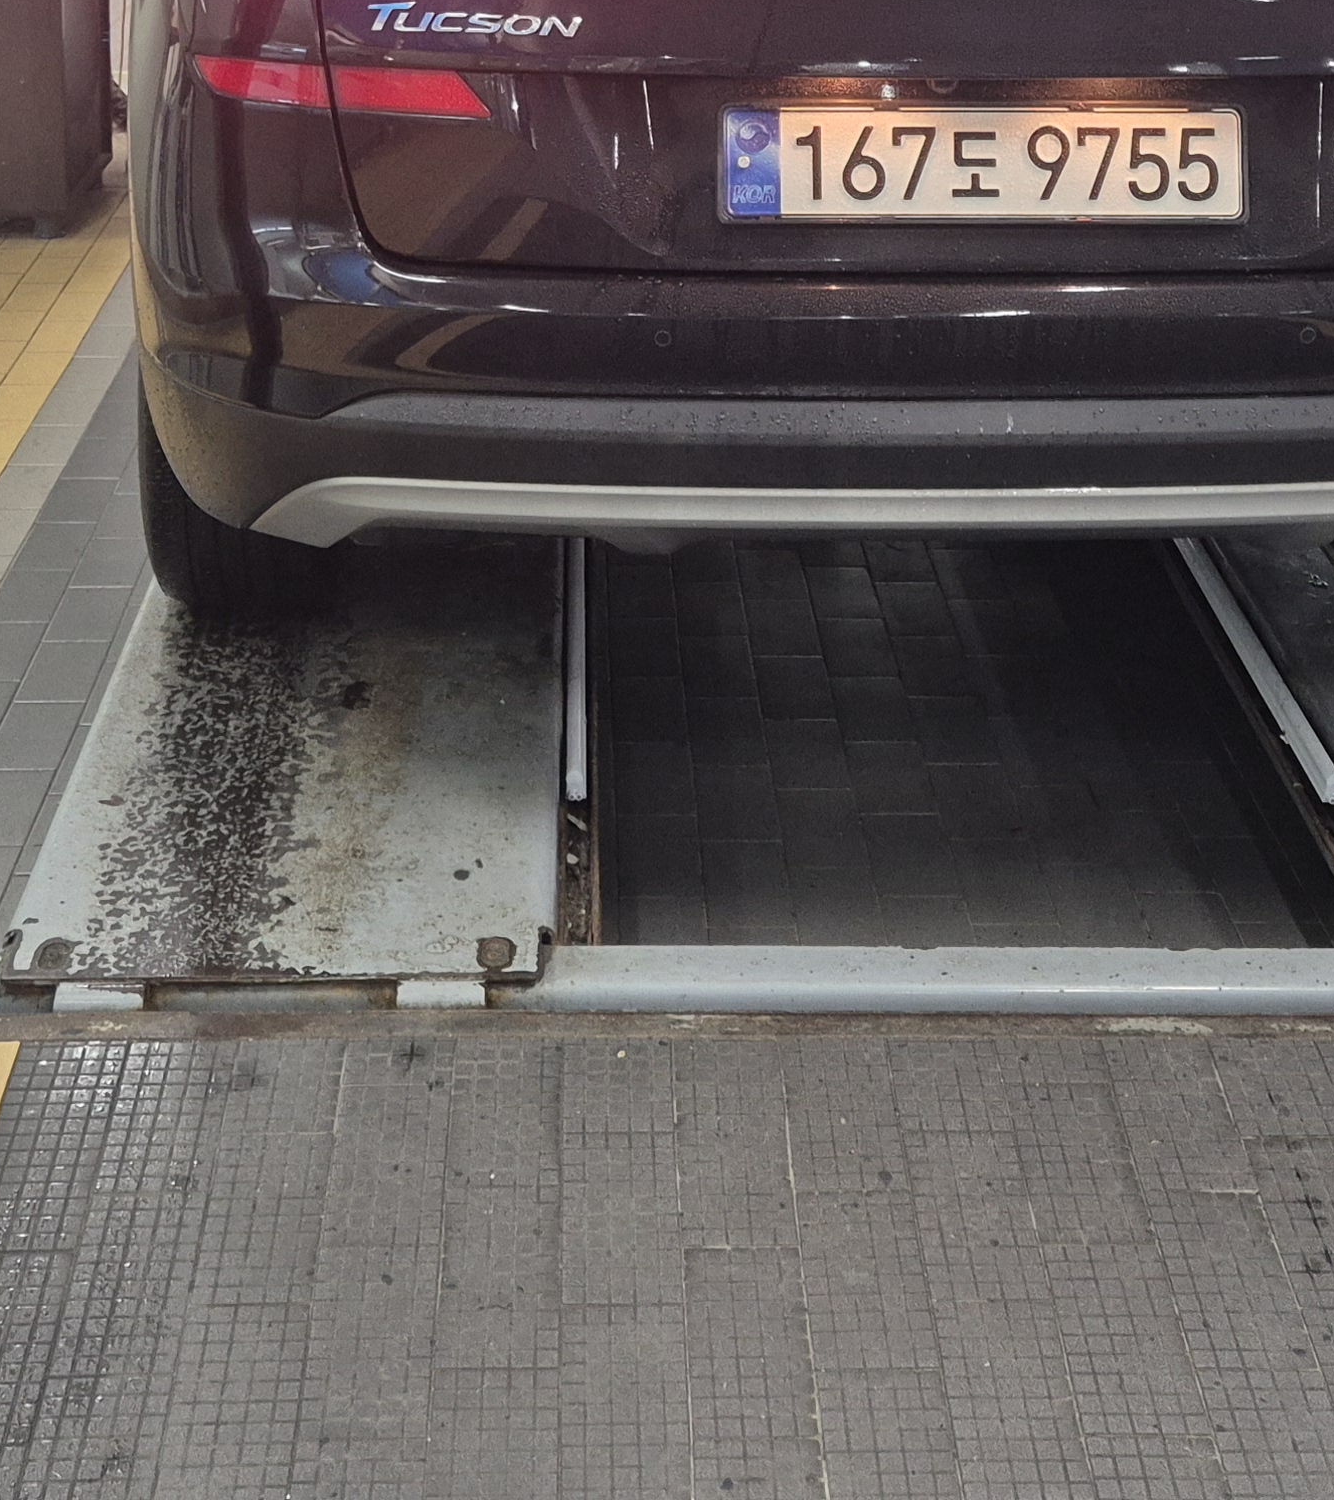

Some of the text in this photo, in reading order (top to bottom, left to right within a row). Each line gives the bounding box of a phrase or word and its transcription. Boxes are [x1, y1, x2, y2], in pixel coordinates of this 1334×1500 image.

[368, 1, 583, 37] TUCSON
[1027, 125, 1220, 202] 9755
[731, 184, 777, 204] KOR
